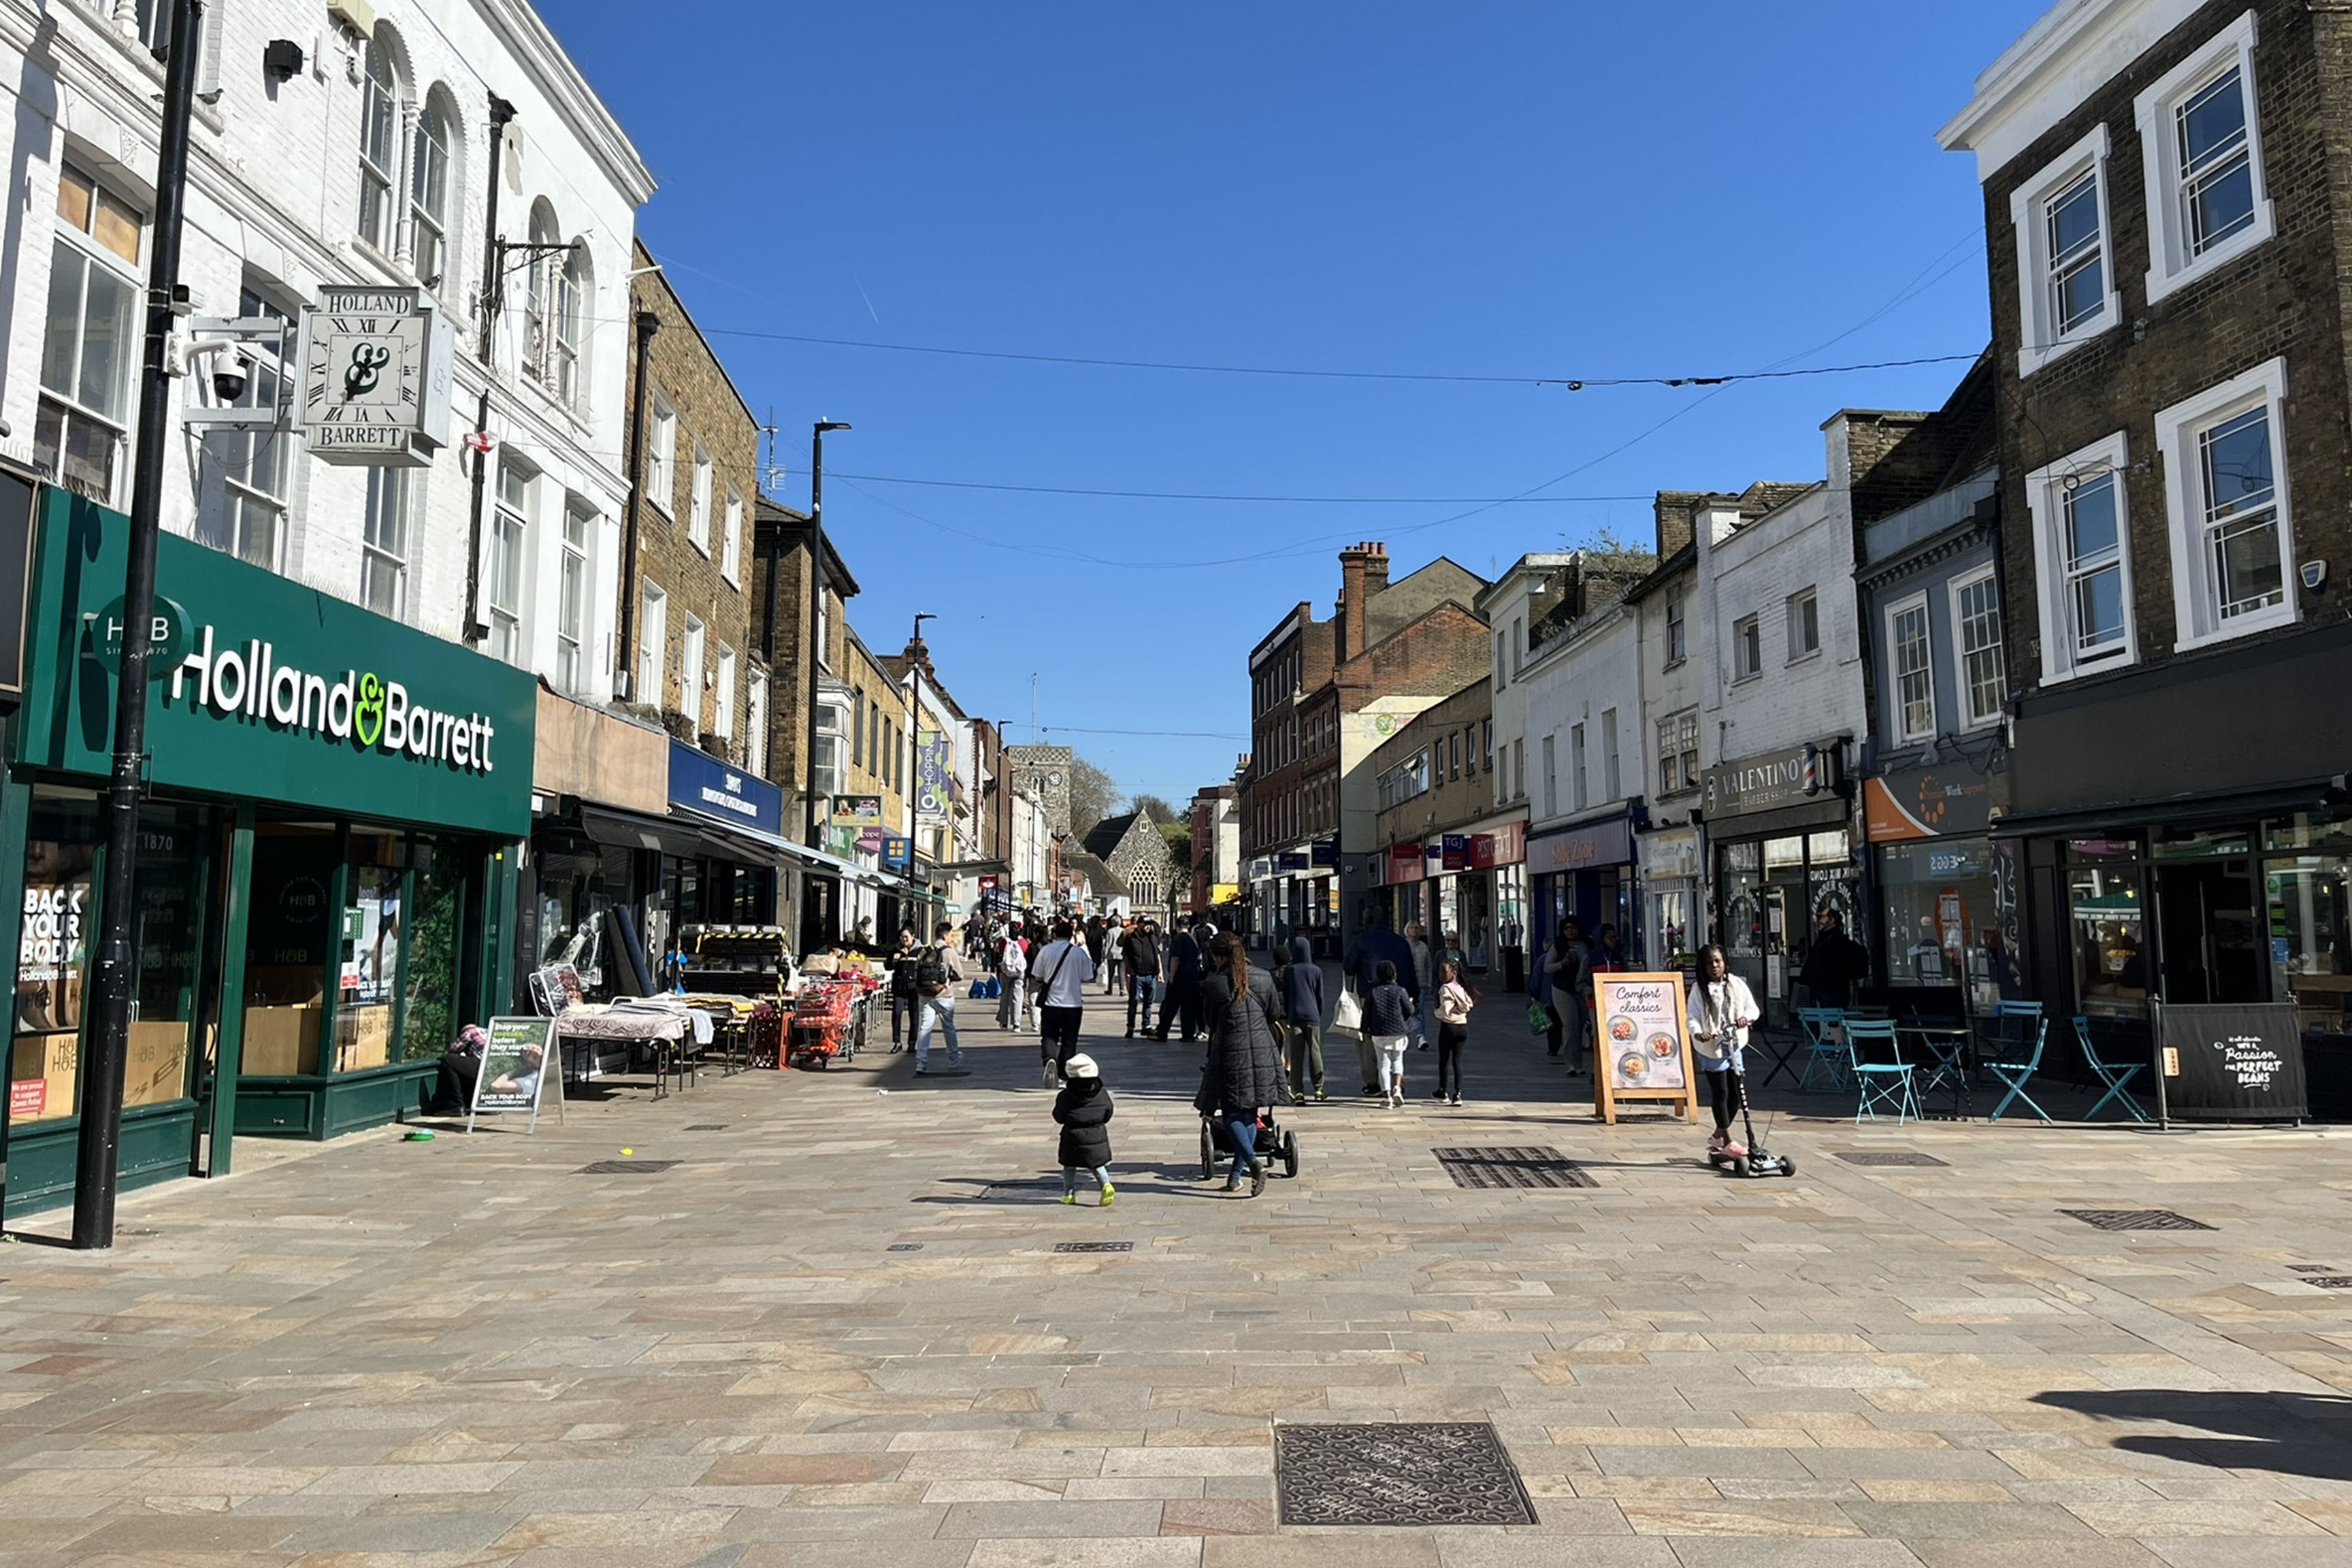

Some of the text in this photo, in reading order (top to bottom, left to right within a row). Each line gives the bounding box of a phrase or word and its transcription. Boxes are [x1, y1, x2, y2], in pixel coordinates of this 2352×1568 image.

[329, 294, 408, 314] HOLLAND
[321, 427, 400, 446] BARRETT
[107, 617, 169, 641] HB
[924, 736, 934, 793] SHOPPING
[1744, 789, 1788, 806] BARBER SHOP
[144, 835, 173, 850] 1870
[1444, 836, 1463, 849] TGJ
[1477, 838, 1490, 859] POST
[24, 889, 83, 914] BACK
[23, 914, 80, 938] YOUR
[21, 938, 80, 963] BODY
[1616, 986, 1661, 1004] Comfort
[1620, 1001, 1662, 1013] classics
[495, 1023, 512, 1031] Stop
[2225, 1047, 2278, 1062] Passion
[2236, 1060, 2283, 1073] PERFECT
[2238, 1071, 2270, 1084] BEANS
